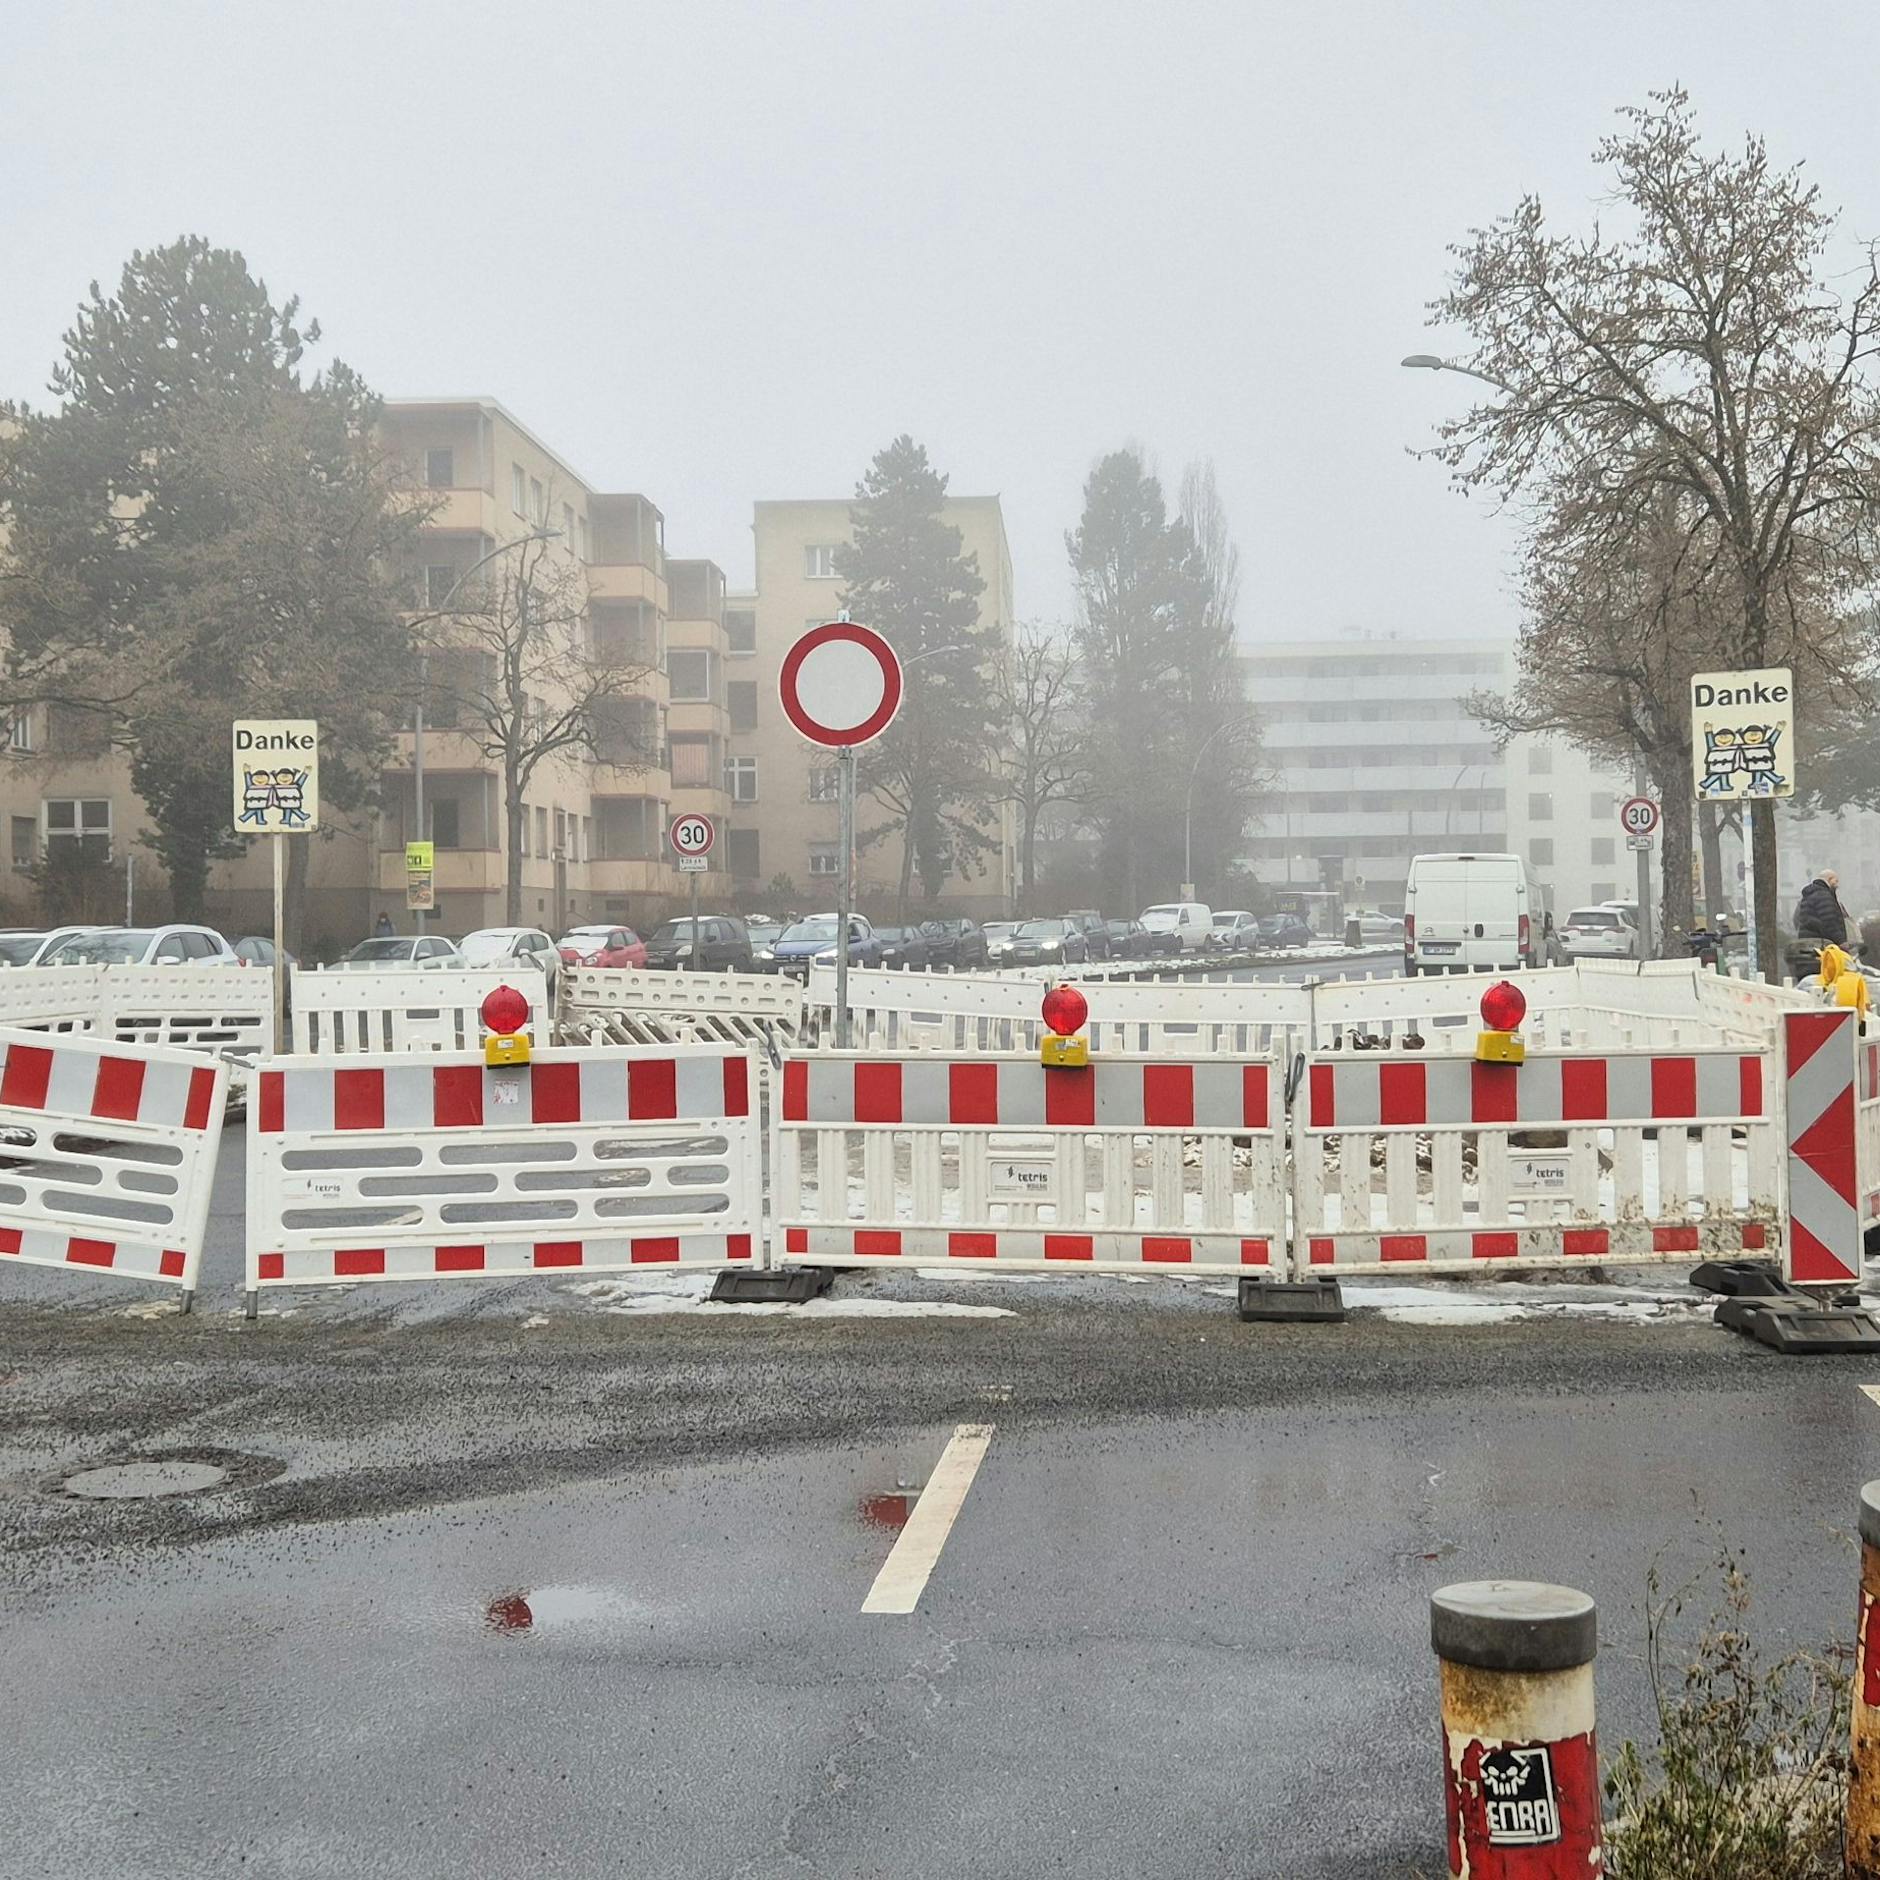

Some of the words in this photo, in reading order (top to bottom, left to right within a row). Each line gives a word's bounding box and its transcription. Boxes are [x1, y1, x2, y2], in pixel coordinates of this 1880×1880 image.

[1695, 681, 1788, 707] Danke
[236, 730, 315, 750] Danke
[1629, 808, 1650, 824] 30
[680, 825, 704, 844] 30
[1018, 1172, 1048, 1182] tetris
